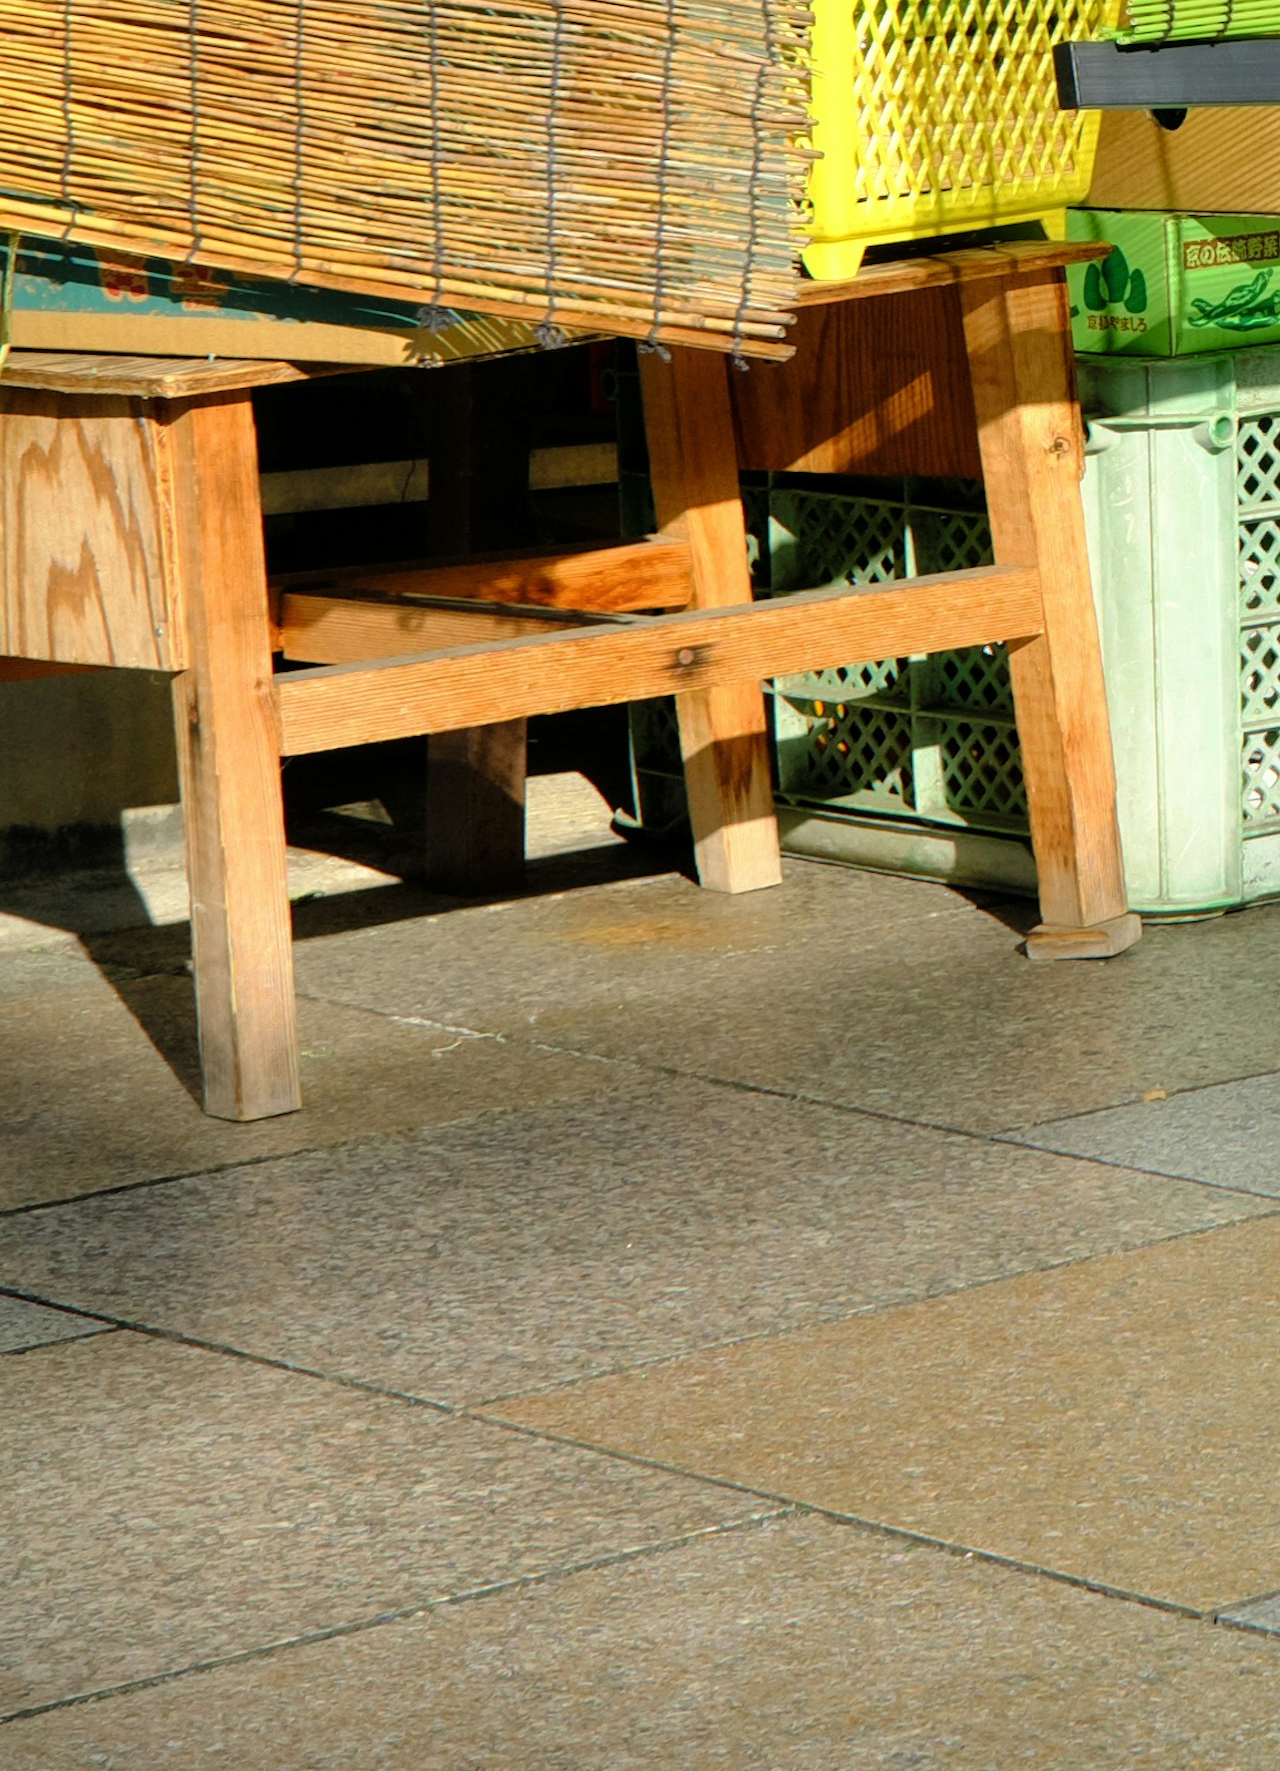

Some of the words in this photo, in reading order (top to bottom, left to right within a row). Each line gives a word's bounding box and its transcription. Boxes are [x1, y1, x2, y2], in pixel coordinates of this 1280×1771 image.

[1185, 233, 1279, 268] 京の伝統野菜
[1086, 314, 1148, 333] 京都やましろ
